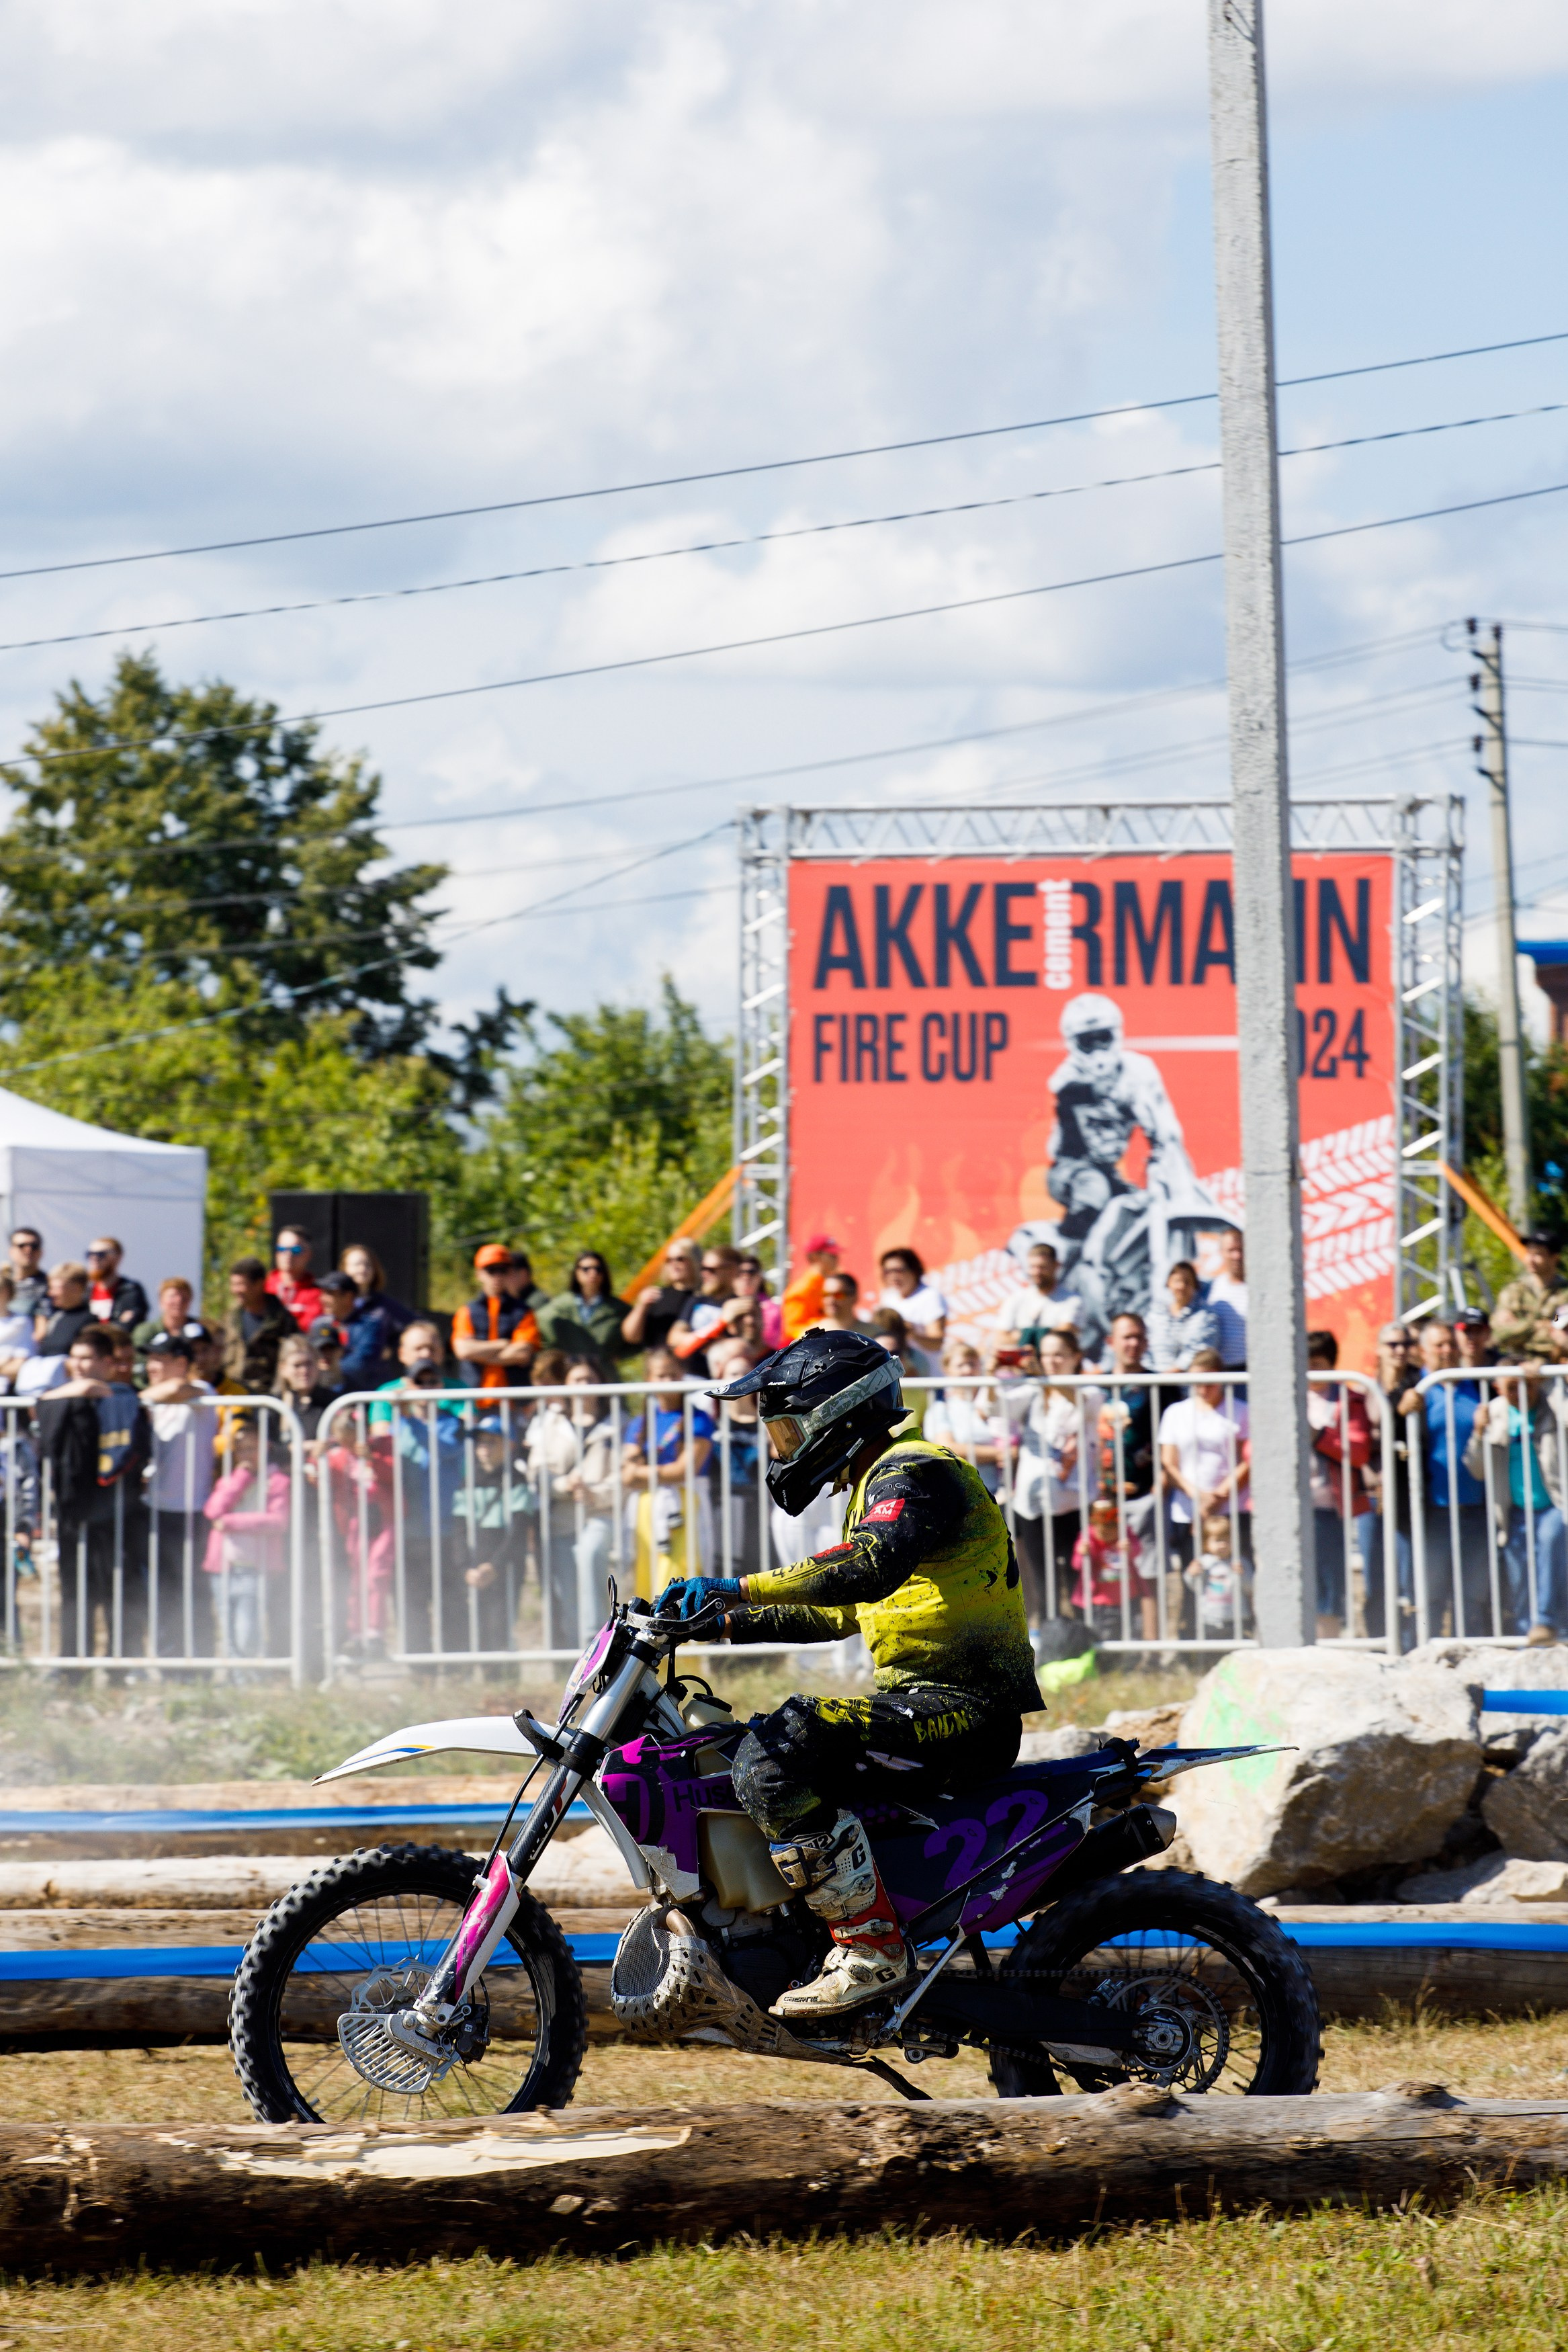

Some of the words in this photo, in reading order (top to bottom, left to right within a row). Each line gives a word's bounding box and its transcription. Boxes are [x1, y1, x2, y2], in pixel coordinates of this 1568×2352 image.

[813, 878, 1371, 989] AKKERMAN
[1037, 878, 1072, 990] cement
[814, 1013, 908, 1083] FIRE
[921, 1011, 1009, 1082] CUP
